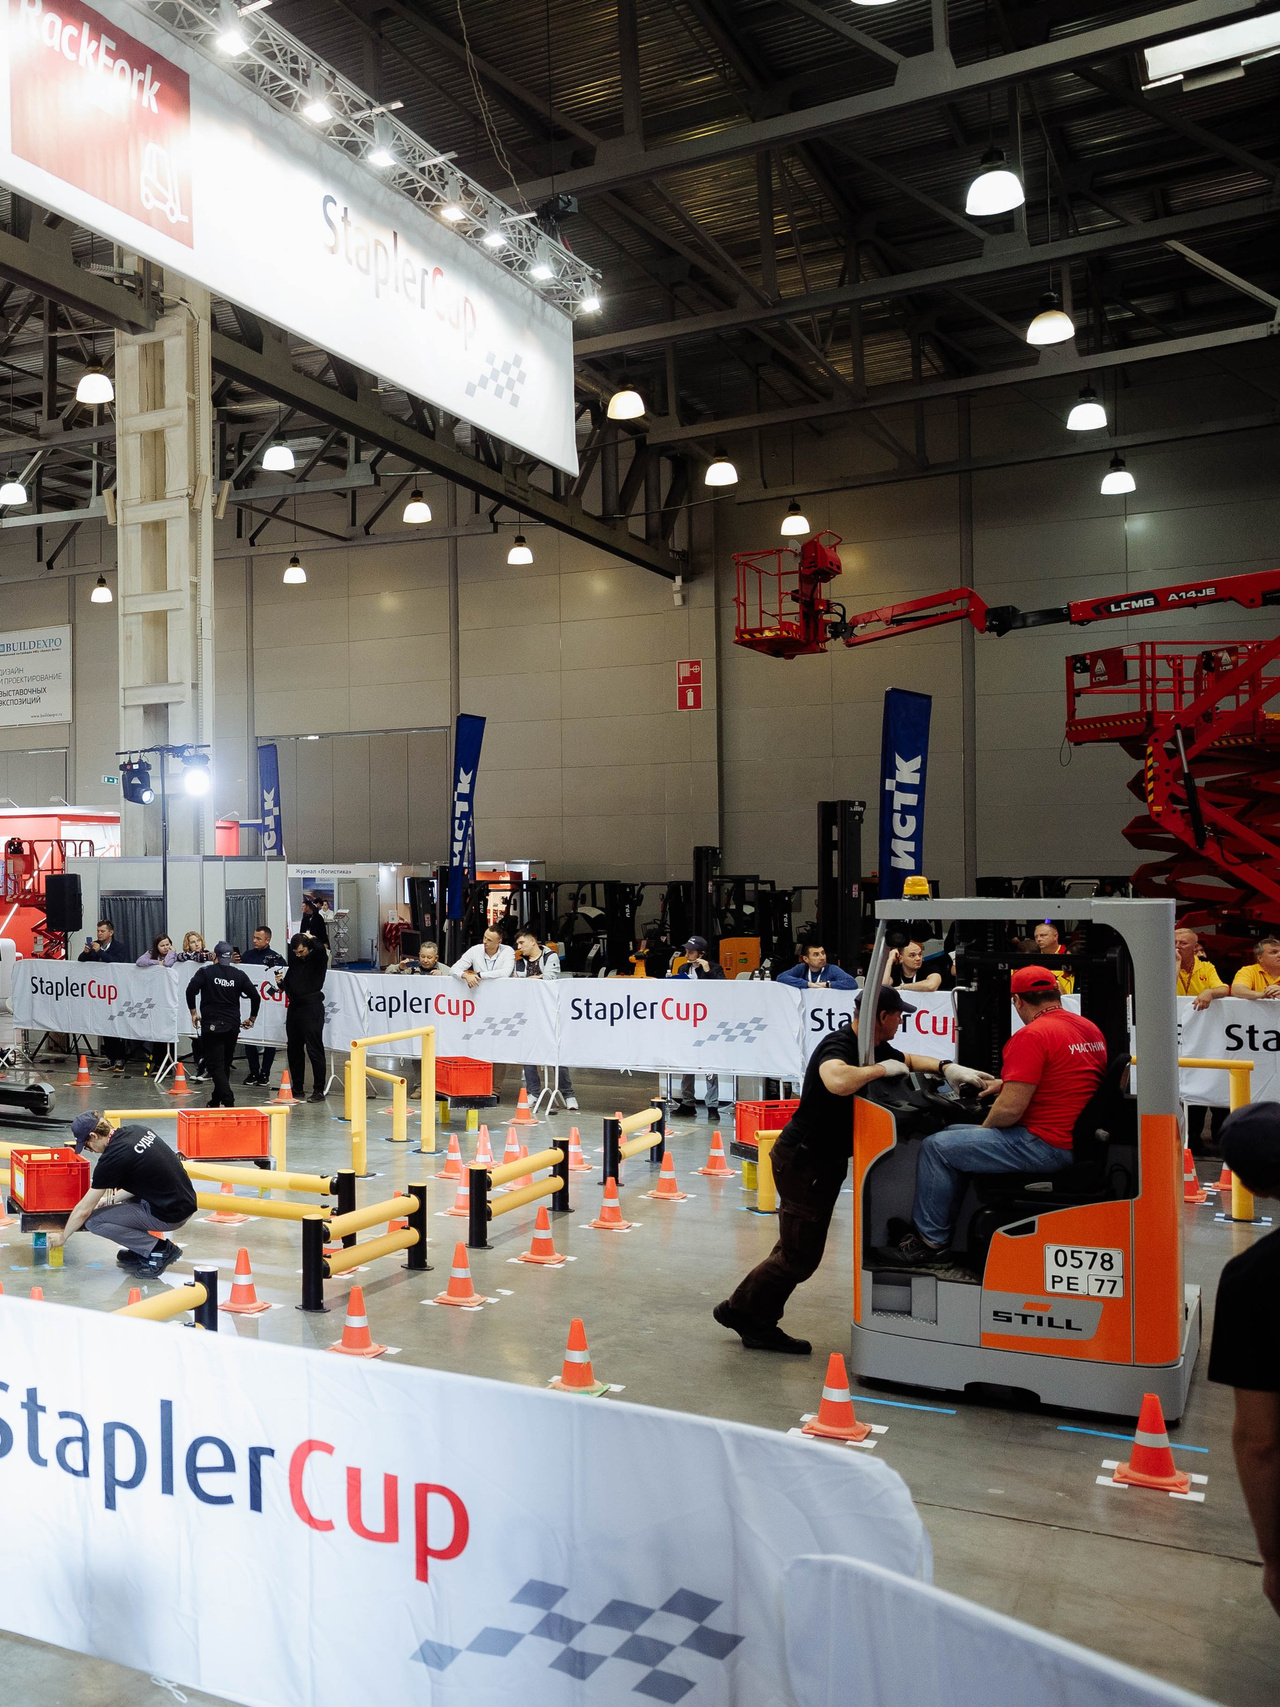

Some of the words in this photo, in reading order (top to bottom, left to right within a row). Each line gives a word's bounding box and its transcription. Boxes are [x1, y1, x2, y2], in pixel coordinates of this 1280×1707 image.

[19, 0, 161, 115] RackFork
[323, 194, 477, 351] StaplerCup
[1167, 587, 1216, 602] A14JE
[6, 637, 62, 653] BUILDEXPO
[4, 673, 62, 684] ПРОЕКТИРОВАНИЕ
[30, 976, 118, 1004] StaplerCup
[214, 977, 235, 987] СУДЬЯ
[368, 990, 476, 1022] taplerCup
[571, 994, 708, 1028] StaplerCup
[134, 1130, 157, 1154] СУДЬЯ
[1054, 1249, 1114, 1271] 0578
[1094, 1278, 1118, 1294] 77
[992, 1310, 1083, 1331] STILL
